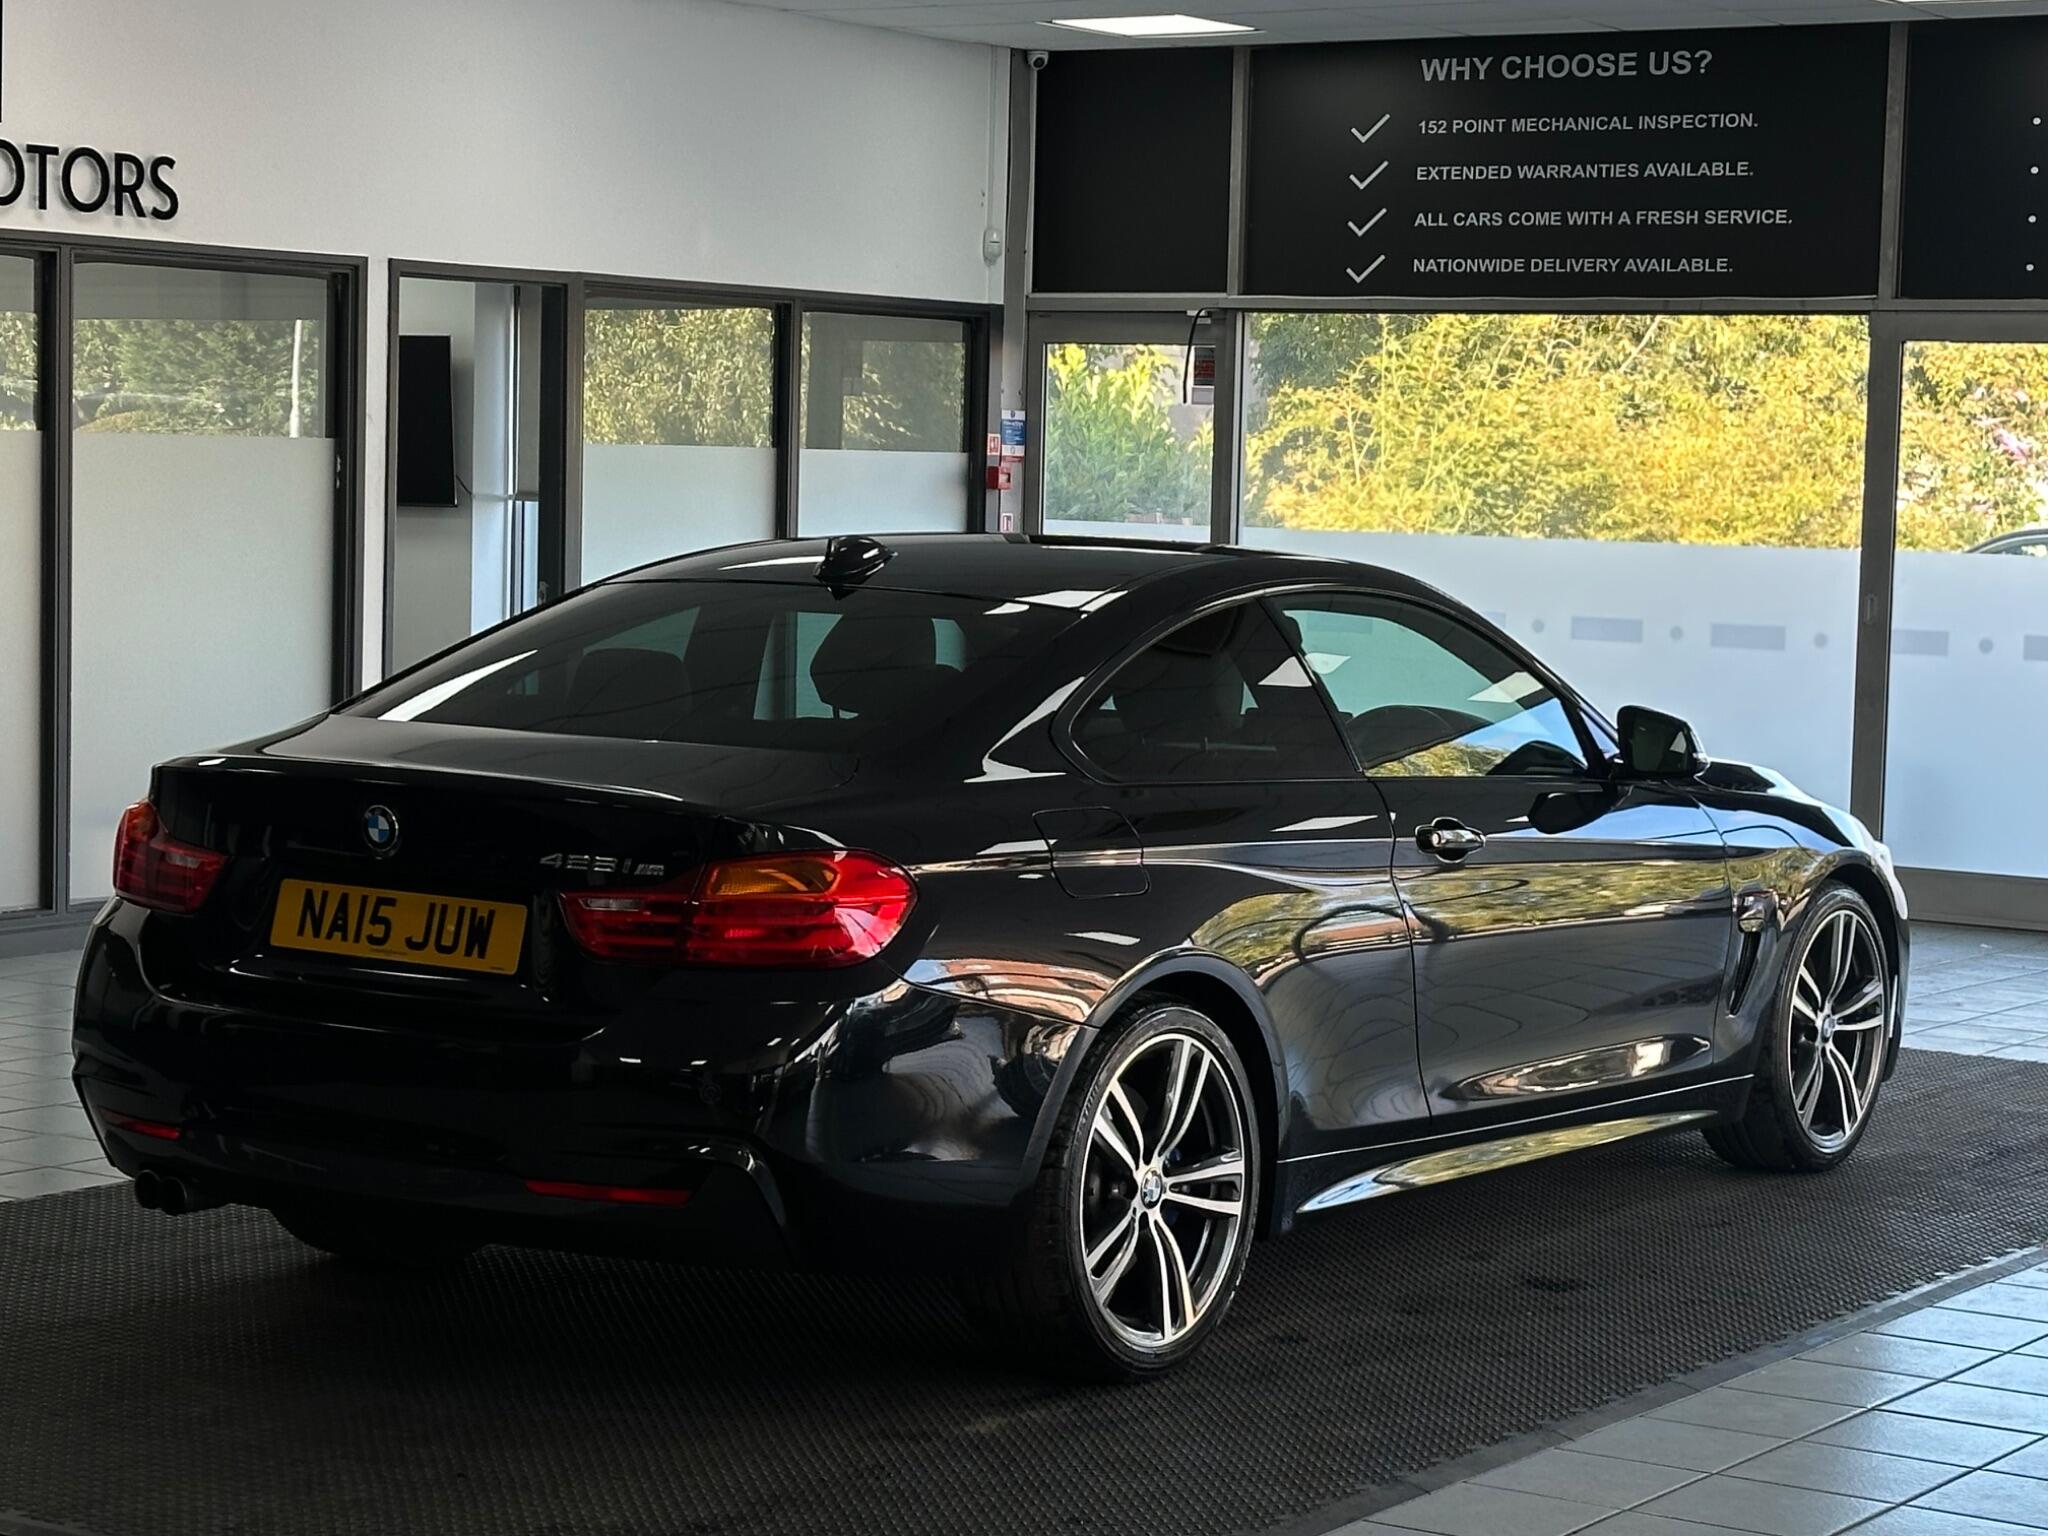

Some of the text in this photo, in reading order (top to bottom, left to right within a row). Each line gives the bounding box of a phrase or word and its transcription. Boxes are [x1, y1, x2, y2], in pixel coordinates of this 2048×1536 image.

[1421, 50, 1713, 82] WHY CHOOSE US?
[1418, 112, 1758, 135] 152 POINT MECHANICAL INSPECTION.
[1416, 161, 1754, 181] EXTENDED WARRANTIES AVAILABLE.
[1414, 209, 1793, 227] ALL CARS COME WITH A FRESH SERVICE.
[1413, 258, 1733, 273] NATIONWIDE DELIVERY AVAILABLE.
[297, 888, 496, 960] NA15 JUW
